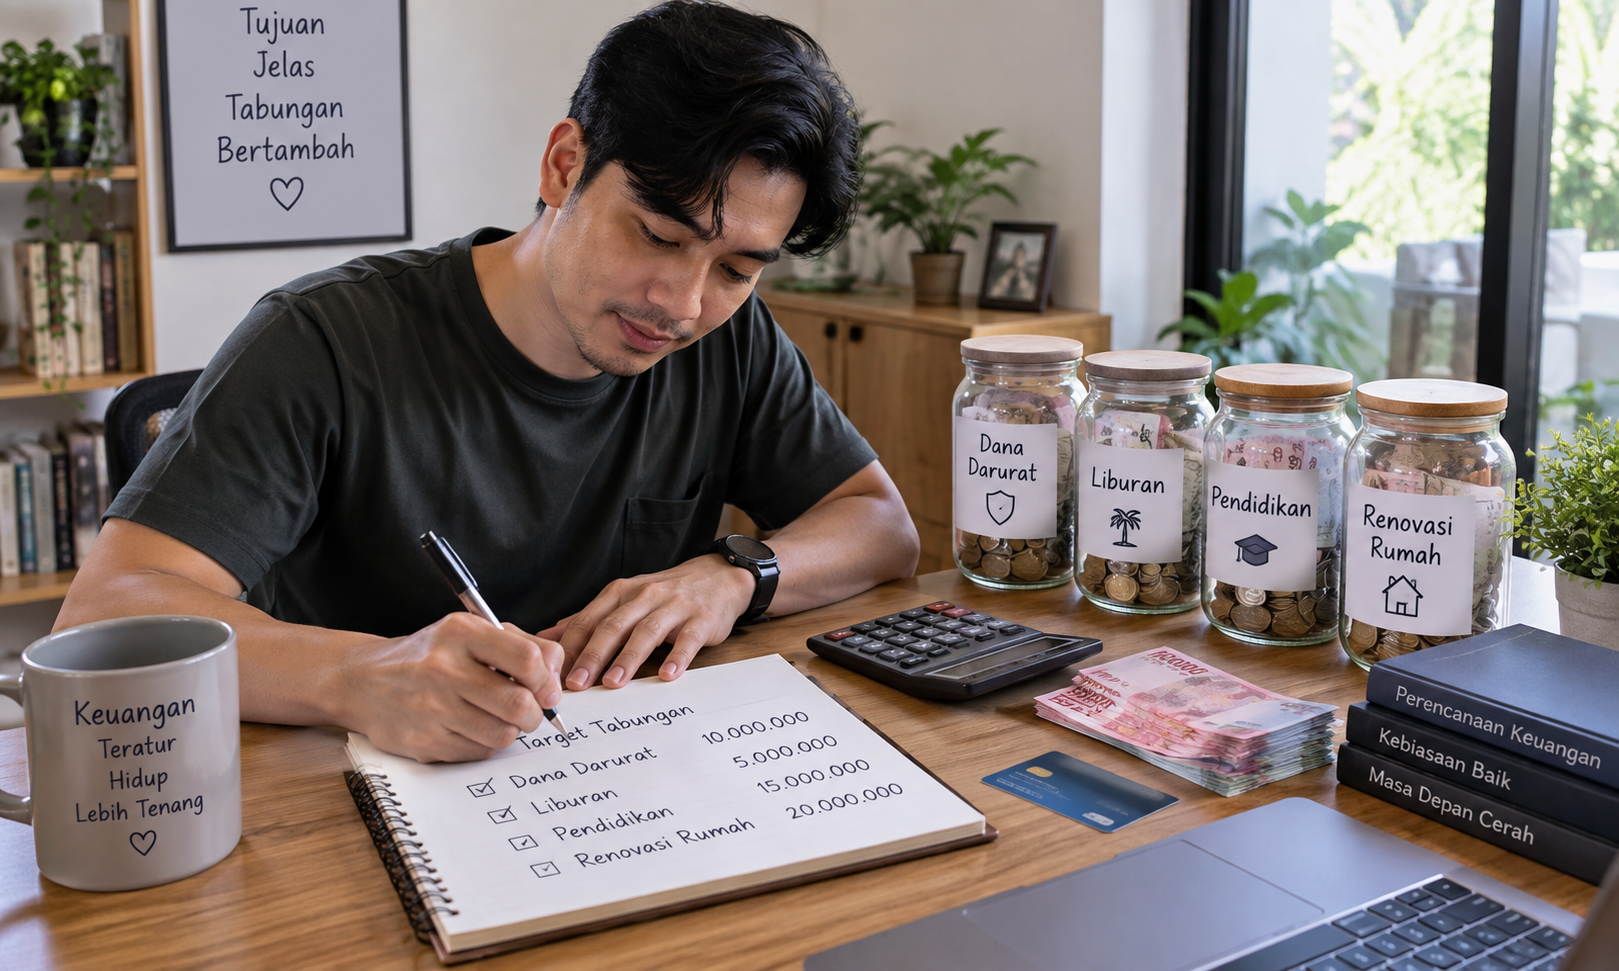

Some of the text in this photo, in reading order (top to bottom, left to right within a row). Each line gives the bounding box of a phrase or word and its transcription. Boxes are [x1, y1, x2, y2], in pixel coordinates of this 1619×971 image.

[240, 7, 325, 45] Tujuan
[253, 50, 315, 78] Jelas
[225, 93, 344, 129] Tabungan
[217, 132, 355, 164] Bertambah
[980, 433, 1024, 456] Dana
[968, 457, 1038, 482] Darurat
[1091, 466, 1165, 494] Liburan
[1211, 485, 1312, 518] Pendidikan
[1363, 504, 1453, 536] Renovasi
[1371, 536, 1441, 566] Rumah
[74, 698, 195, 729] Keuangan
[516, 705, 694, 750] Target Tabungan
[1395, 685, 1601, 770] Perencanaan Keuangan
[98, 736, 176, 759] Teratur
[509, 711, 809, 789] Dana Darurat 10.000.000
[1379, 727, 1512, 791] Kebiasaan Baik
[110, 767, 168, 792] Hidup
[531, 735, 838, 815] Liburan 5.000.000
[75, 795, 203, 823] Lebih Tenang
[552, 759, 870, 841] Pendidikan 15.000.000
[1368, 766, 1535, 845] Masa Depan Cerah
[574, 783, 903, 868] Renovasi Rumah 20.000.000
